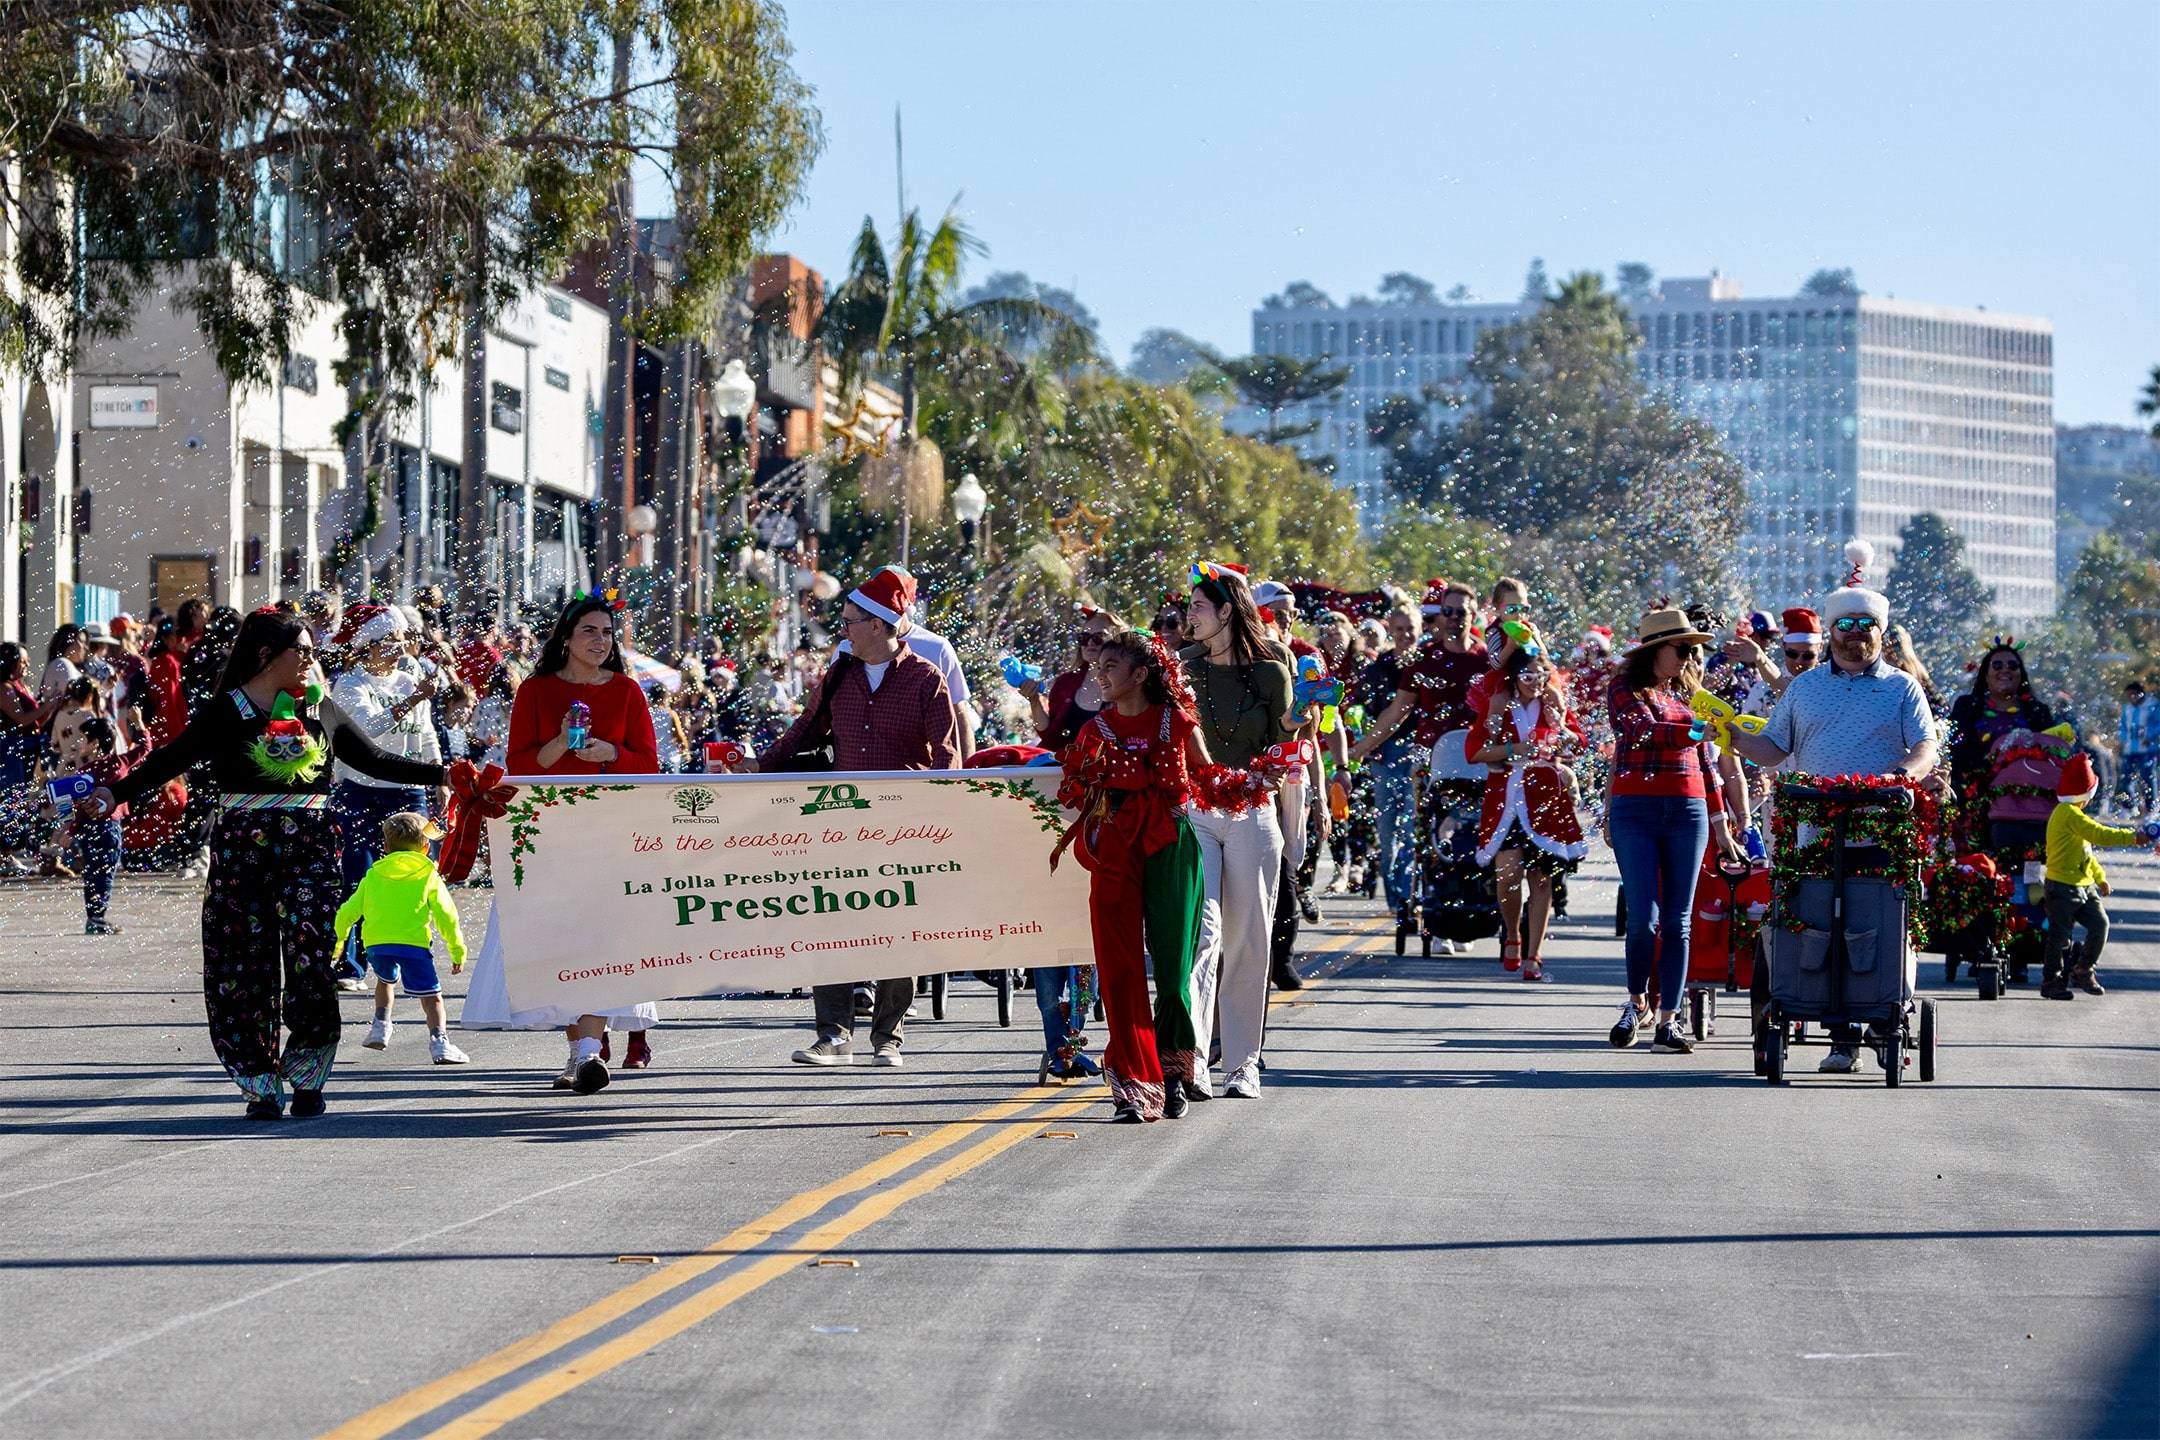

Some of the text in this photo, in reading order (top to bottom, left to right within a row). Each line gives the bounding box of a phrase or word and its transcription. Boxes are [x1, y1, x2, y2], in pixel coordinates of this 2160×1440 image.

[770, 796, 795, 805] 1955
[807, 783, 858, 803] 70
[816, 801, 854, 809] YEARS
[631, 825, 953, 852] 'tis the season to be jolly
[772, 849, 808, 857] WITH
[623, 860, 962, 895] La Jolla Presbyterian Church
[673, 880, 918, 926] Preschool
[557, 920, 1043, 982] Growing Minds Creating Community Fostering Faith
